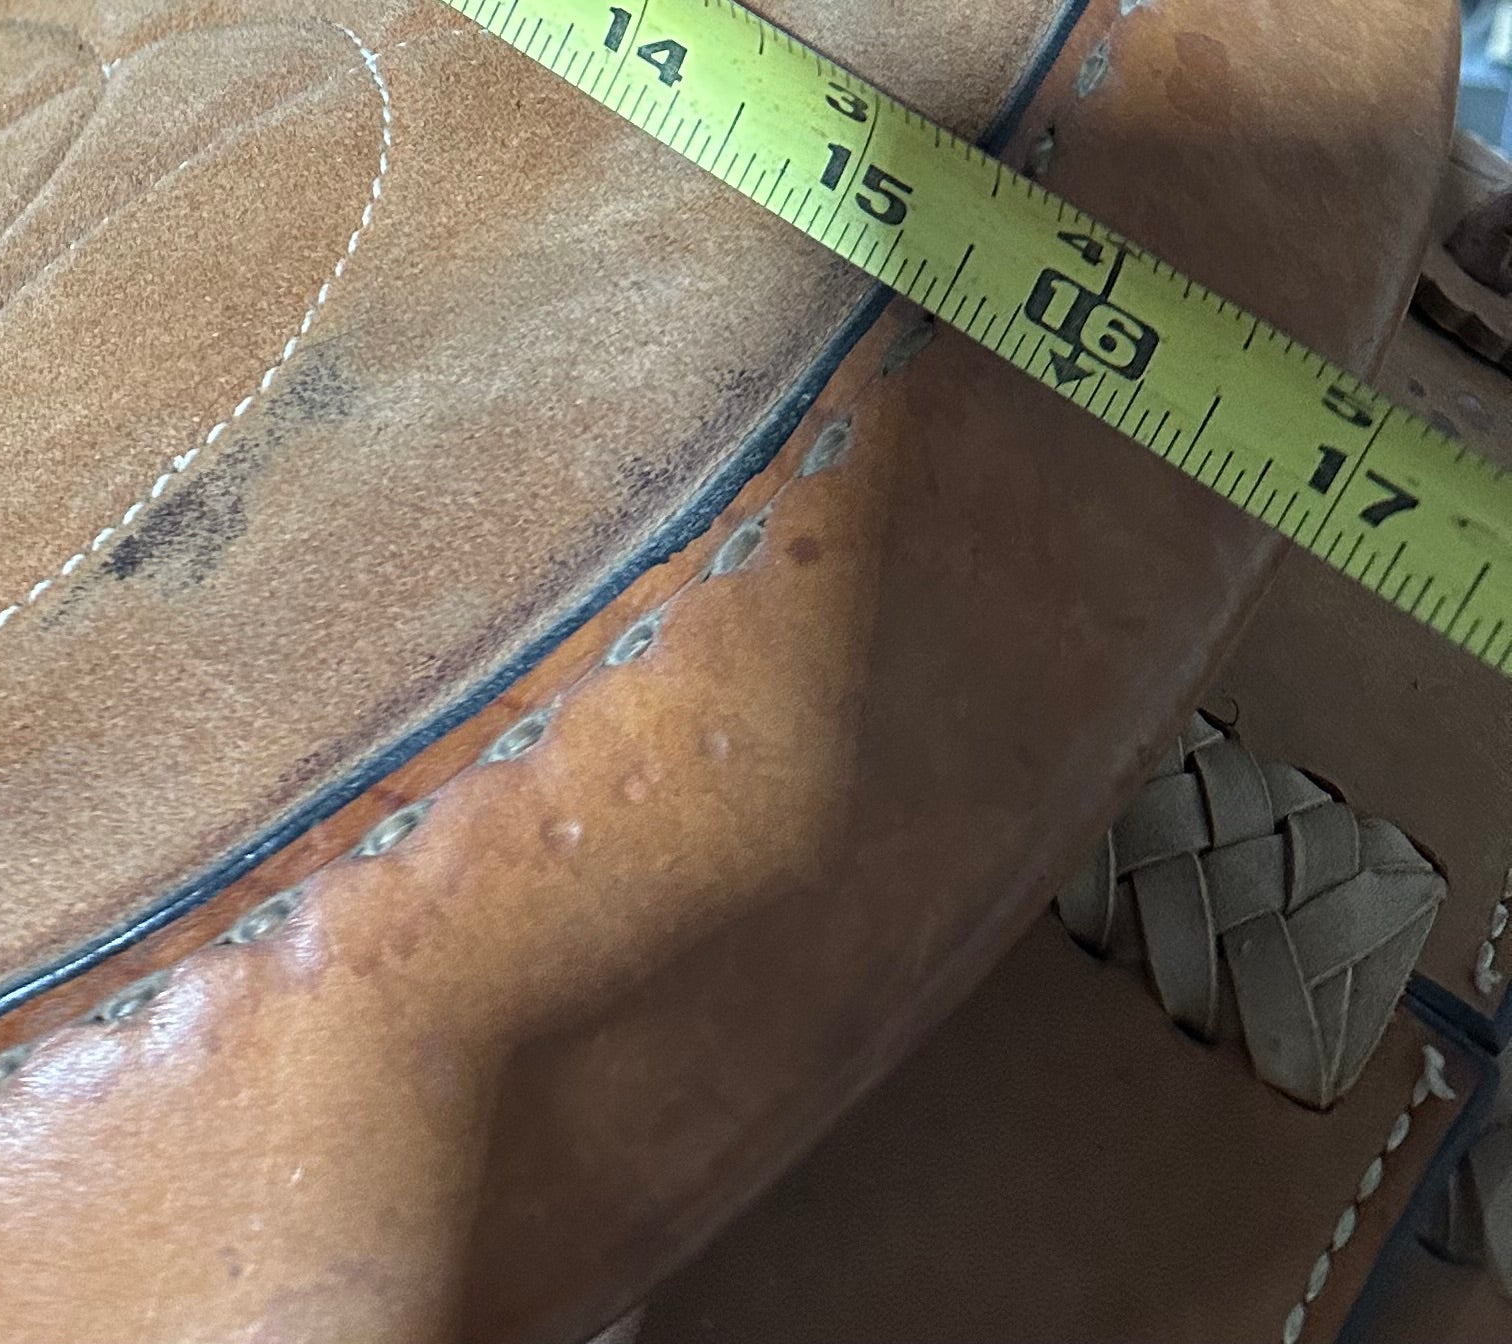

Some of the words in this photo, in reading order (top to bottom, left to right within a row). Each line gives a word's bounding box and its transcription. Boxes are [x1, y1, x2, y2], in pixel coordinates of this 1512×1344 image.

[603, 7, 688, 88] 14
[825, 81, 868, 123] 3
[819, 143, 913, 226] 15
[1057, 230, 1105, 267] 4
[1033, 276, 1142, 370] 16
[1322, 385, 1373, 429] 5
[1306, 444, 1420, 529] 17
